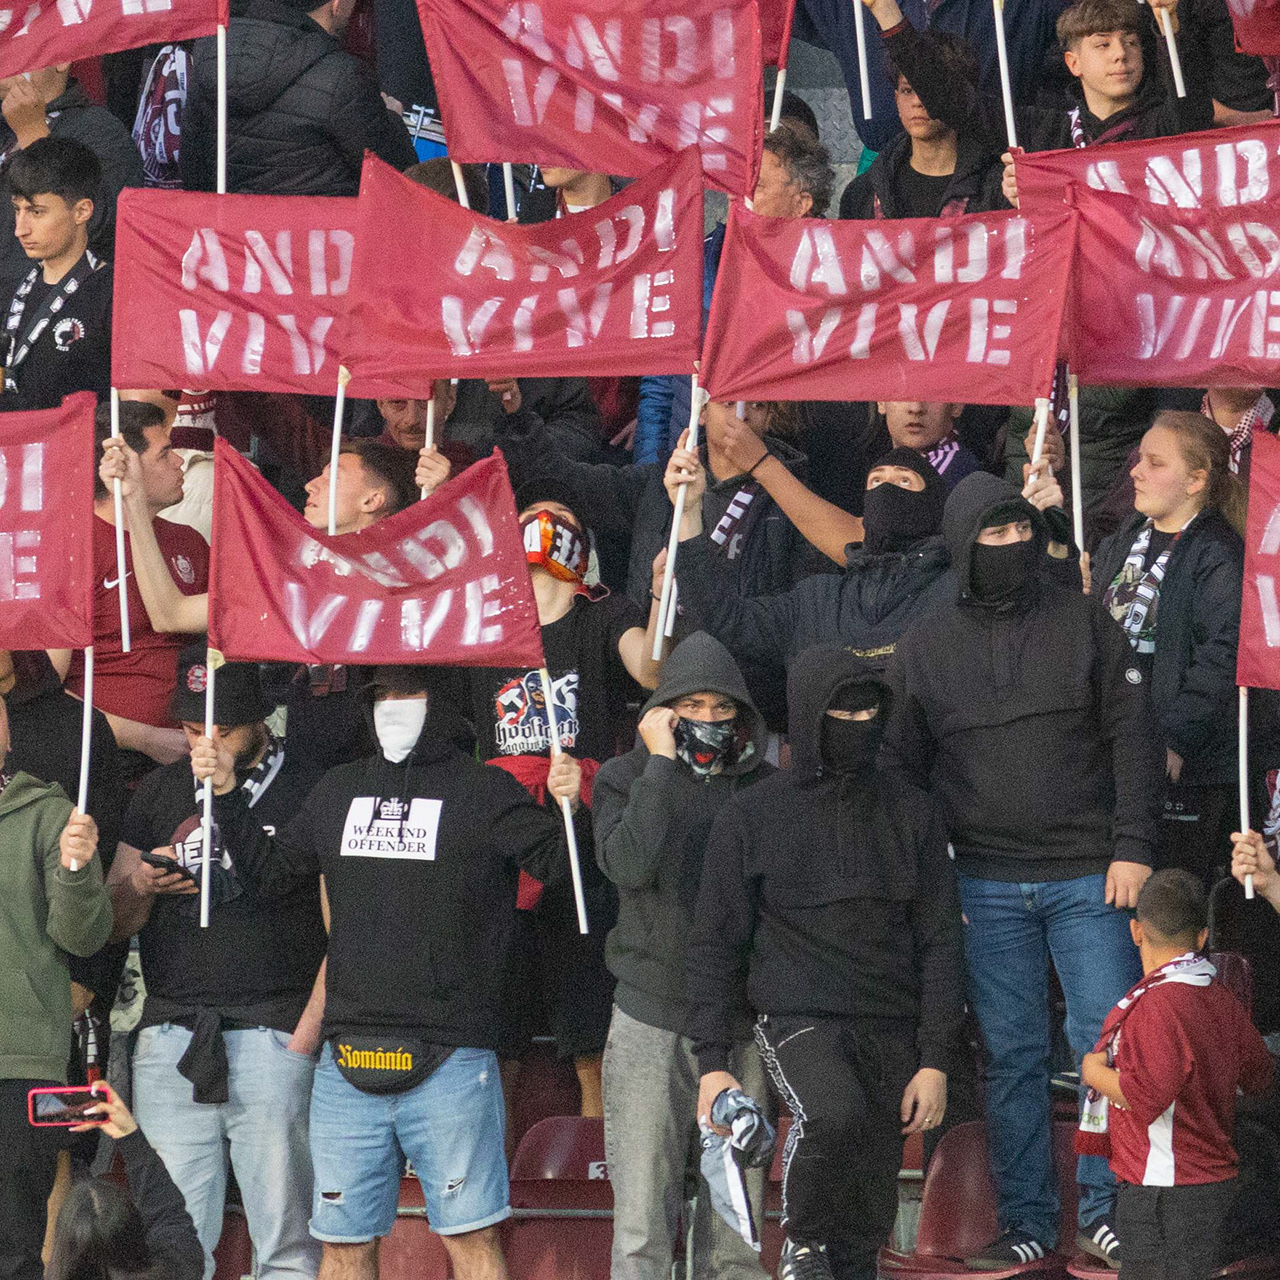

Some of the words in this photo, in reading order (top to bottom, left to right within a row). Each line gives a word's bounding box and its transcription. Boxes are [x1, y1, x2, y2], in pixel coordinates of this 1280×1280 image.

[503, 2, 735, 81] ANDI
[503, 58, 734, 172] VIVE
[182, 228, 354, 296] AND
[454, 187, 675, 280] ANDI
[789, 218, 1032, 295] ANDI
[178, 309, 333, 375] VIV
[442, 270, 675, 356] VIVE
[787, 298, 1018, 366] VIVE
[285, 574, 503, 651] VIVE
[348, 838, 427, 854] OFFENDER
[353, 825, 427, 839] WEEKEND
